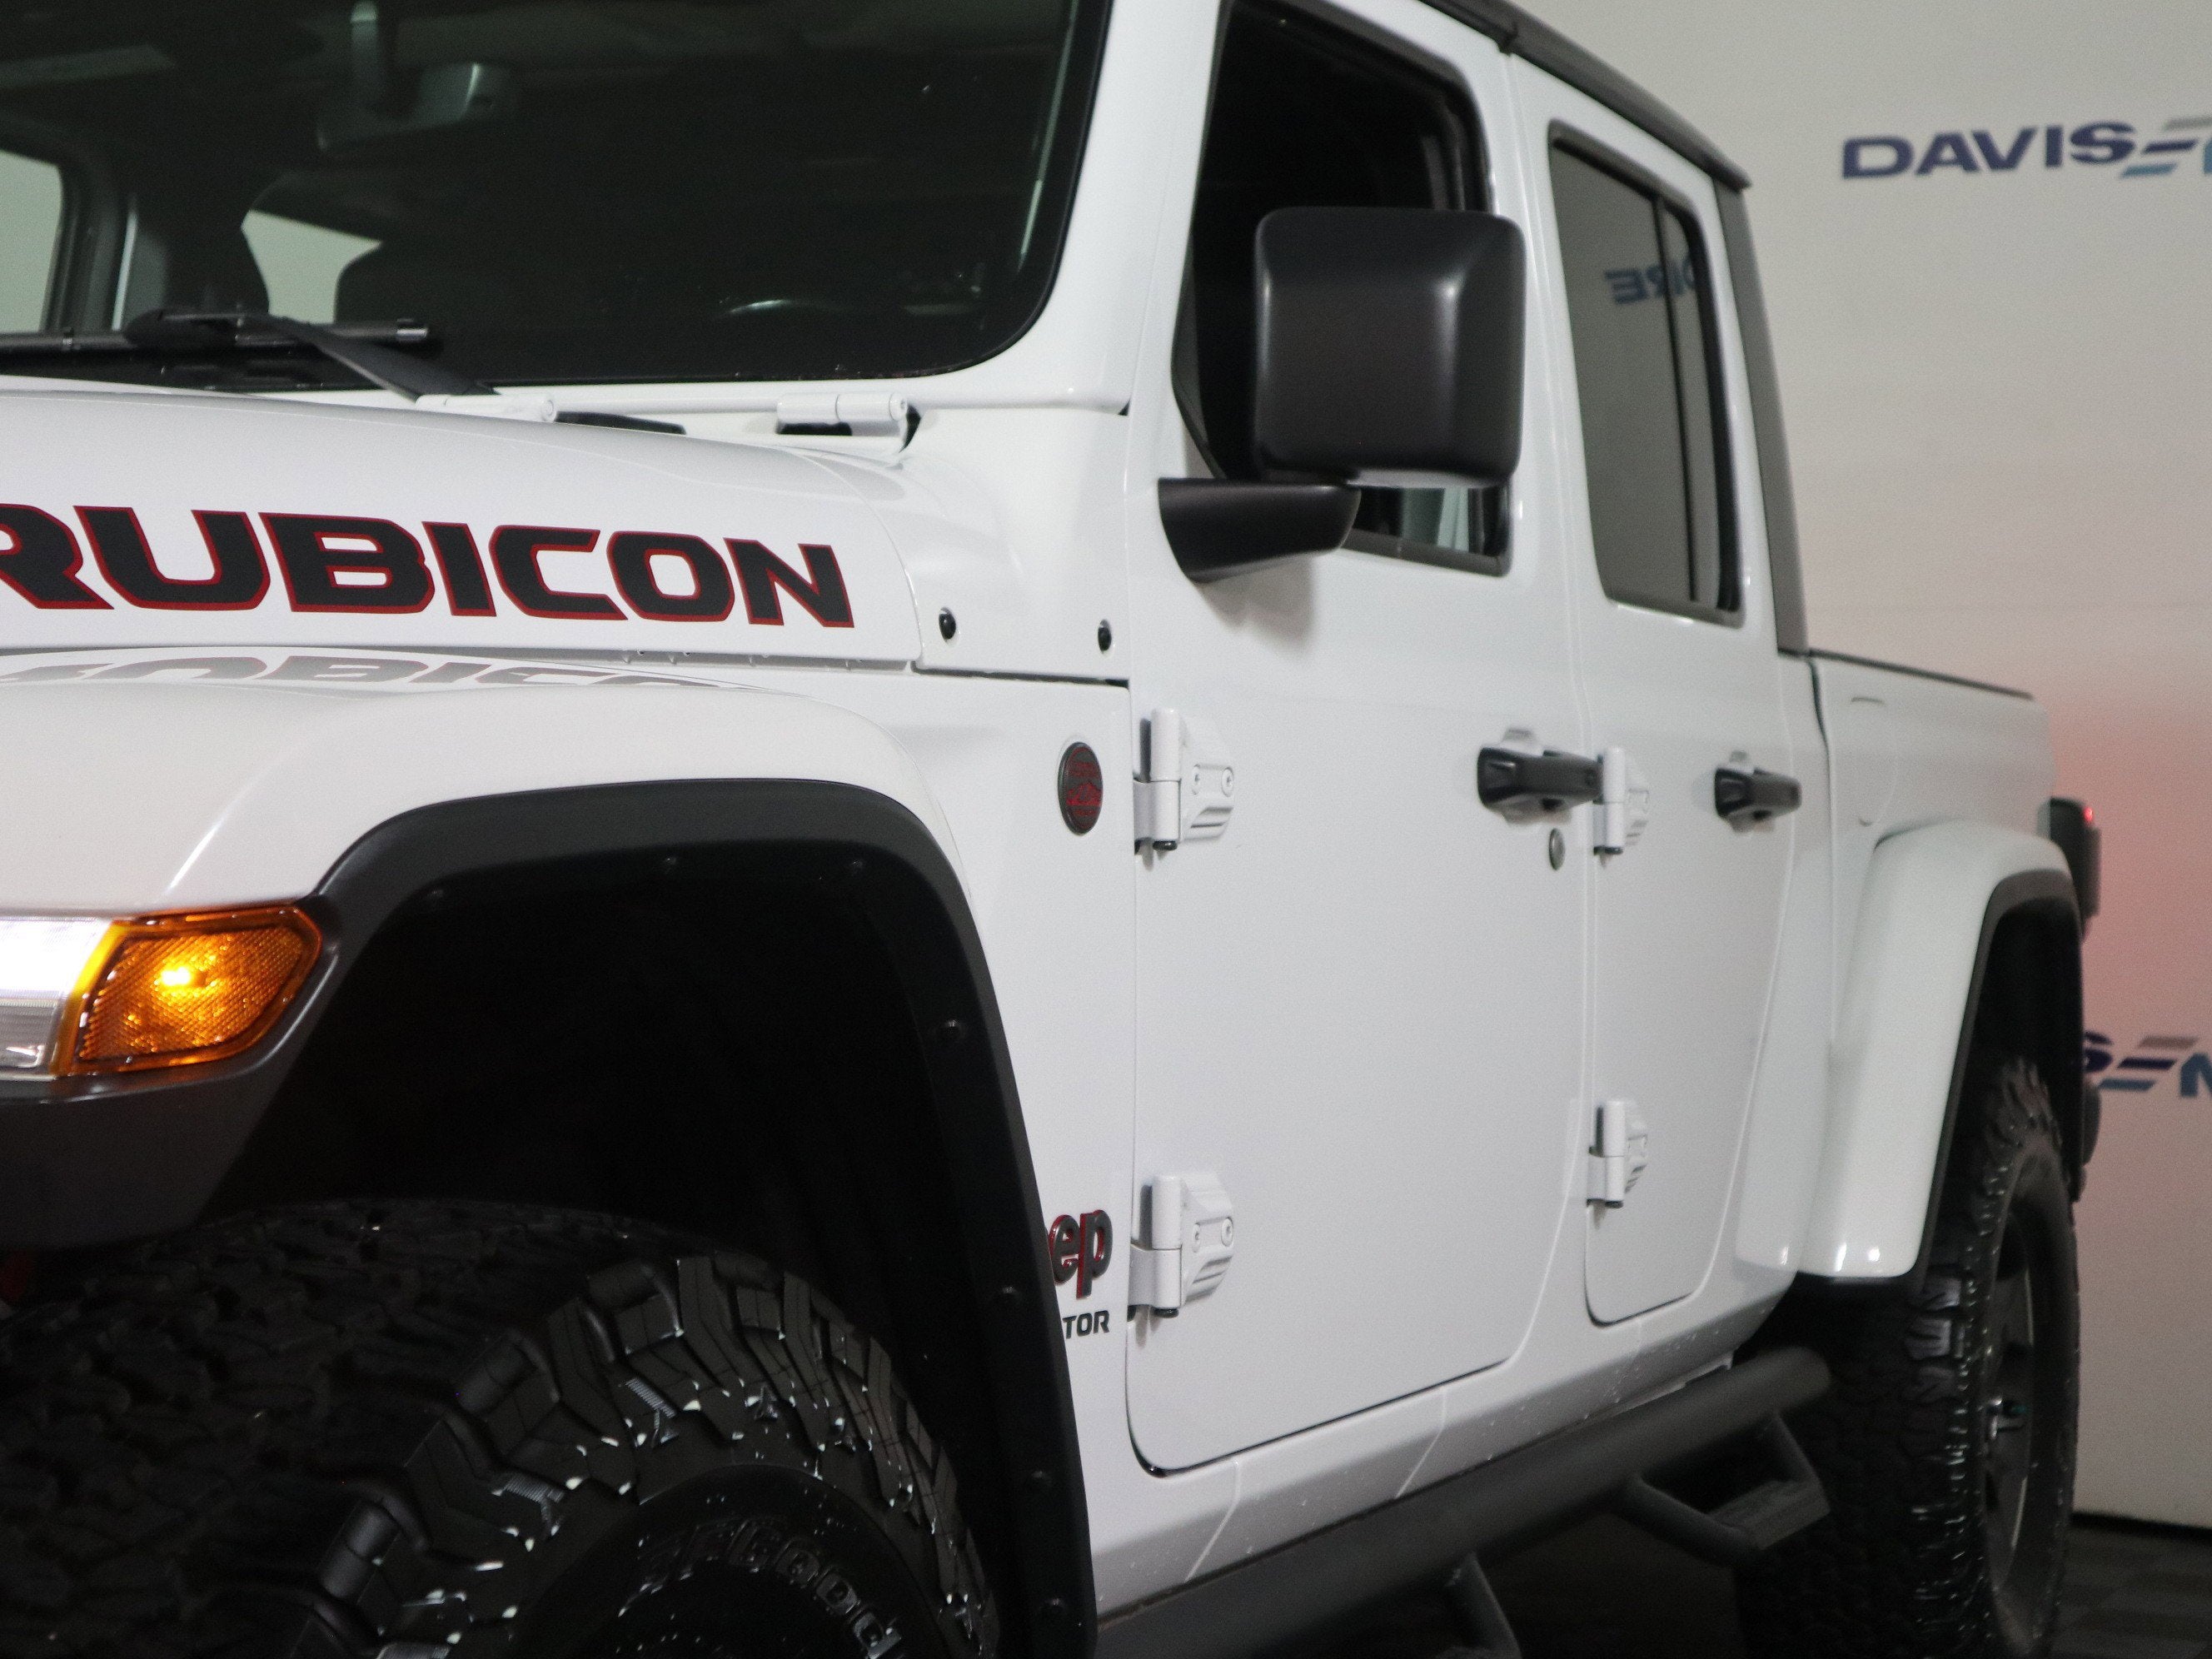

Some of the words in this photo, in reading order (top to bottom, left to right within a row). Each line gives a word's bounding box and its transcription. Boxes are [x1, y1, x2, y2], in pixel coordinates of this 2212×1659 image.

[1841, 121, 2136, 180] DAVIS
[0, 504, 855, 628] RUBICON
[1062, 1309, 1110, 1340] TOR
